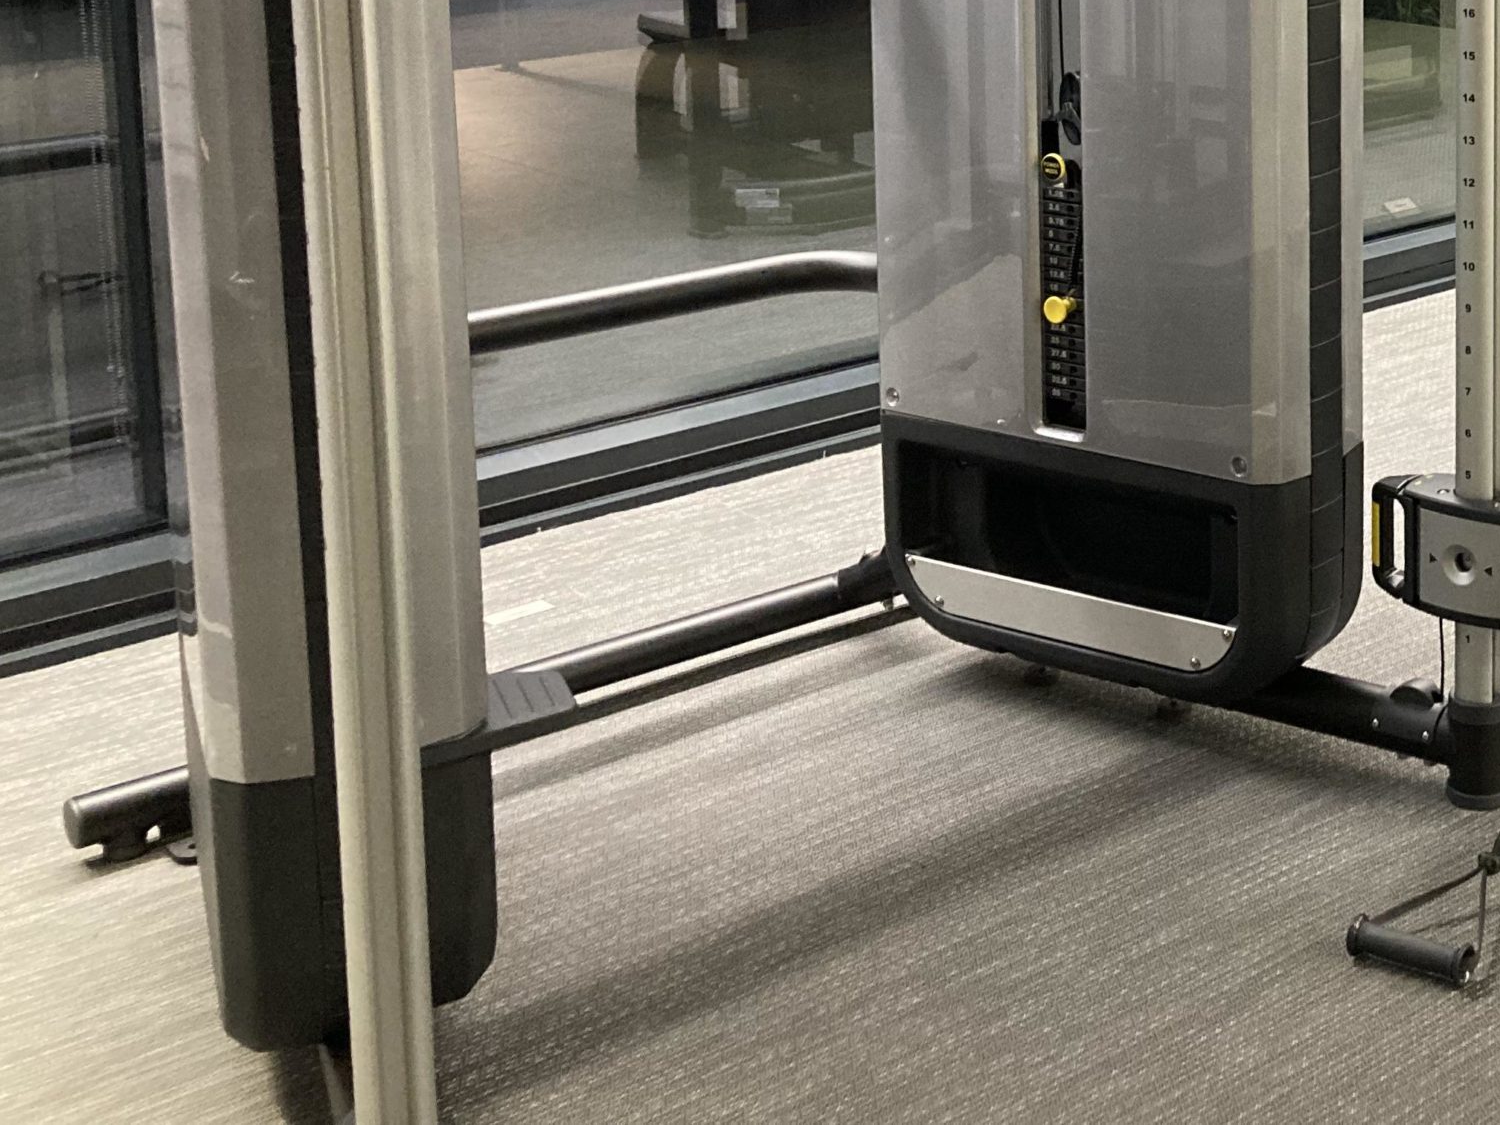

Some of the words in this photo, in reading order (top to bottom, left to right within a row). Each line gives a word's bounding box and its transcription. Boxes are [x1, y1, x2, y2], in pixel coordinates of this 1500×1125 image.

[1463, 8, 1475, 18] 16
[1463, 51, 1475, 60] 15
[1463, 93, 1475, 103] 14
[1463, 136, 1475, 145] 13
[1463, 178, 1475, 187] 12
[1463, 220, 1474, 229] 11
[1463, 262, 1475, 271] 10
[1465, 304, 1471, 313] 9
[1465, 346, 1471, 355] 8
[1465, 387, 1471, 395] 7
[1465, 429, 1471, 438] 6
[1465, 470, 1471, 479] 5
[1465, 635, 1470, 643] 1
